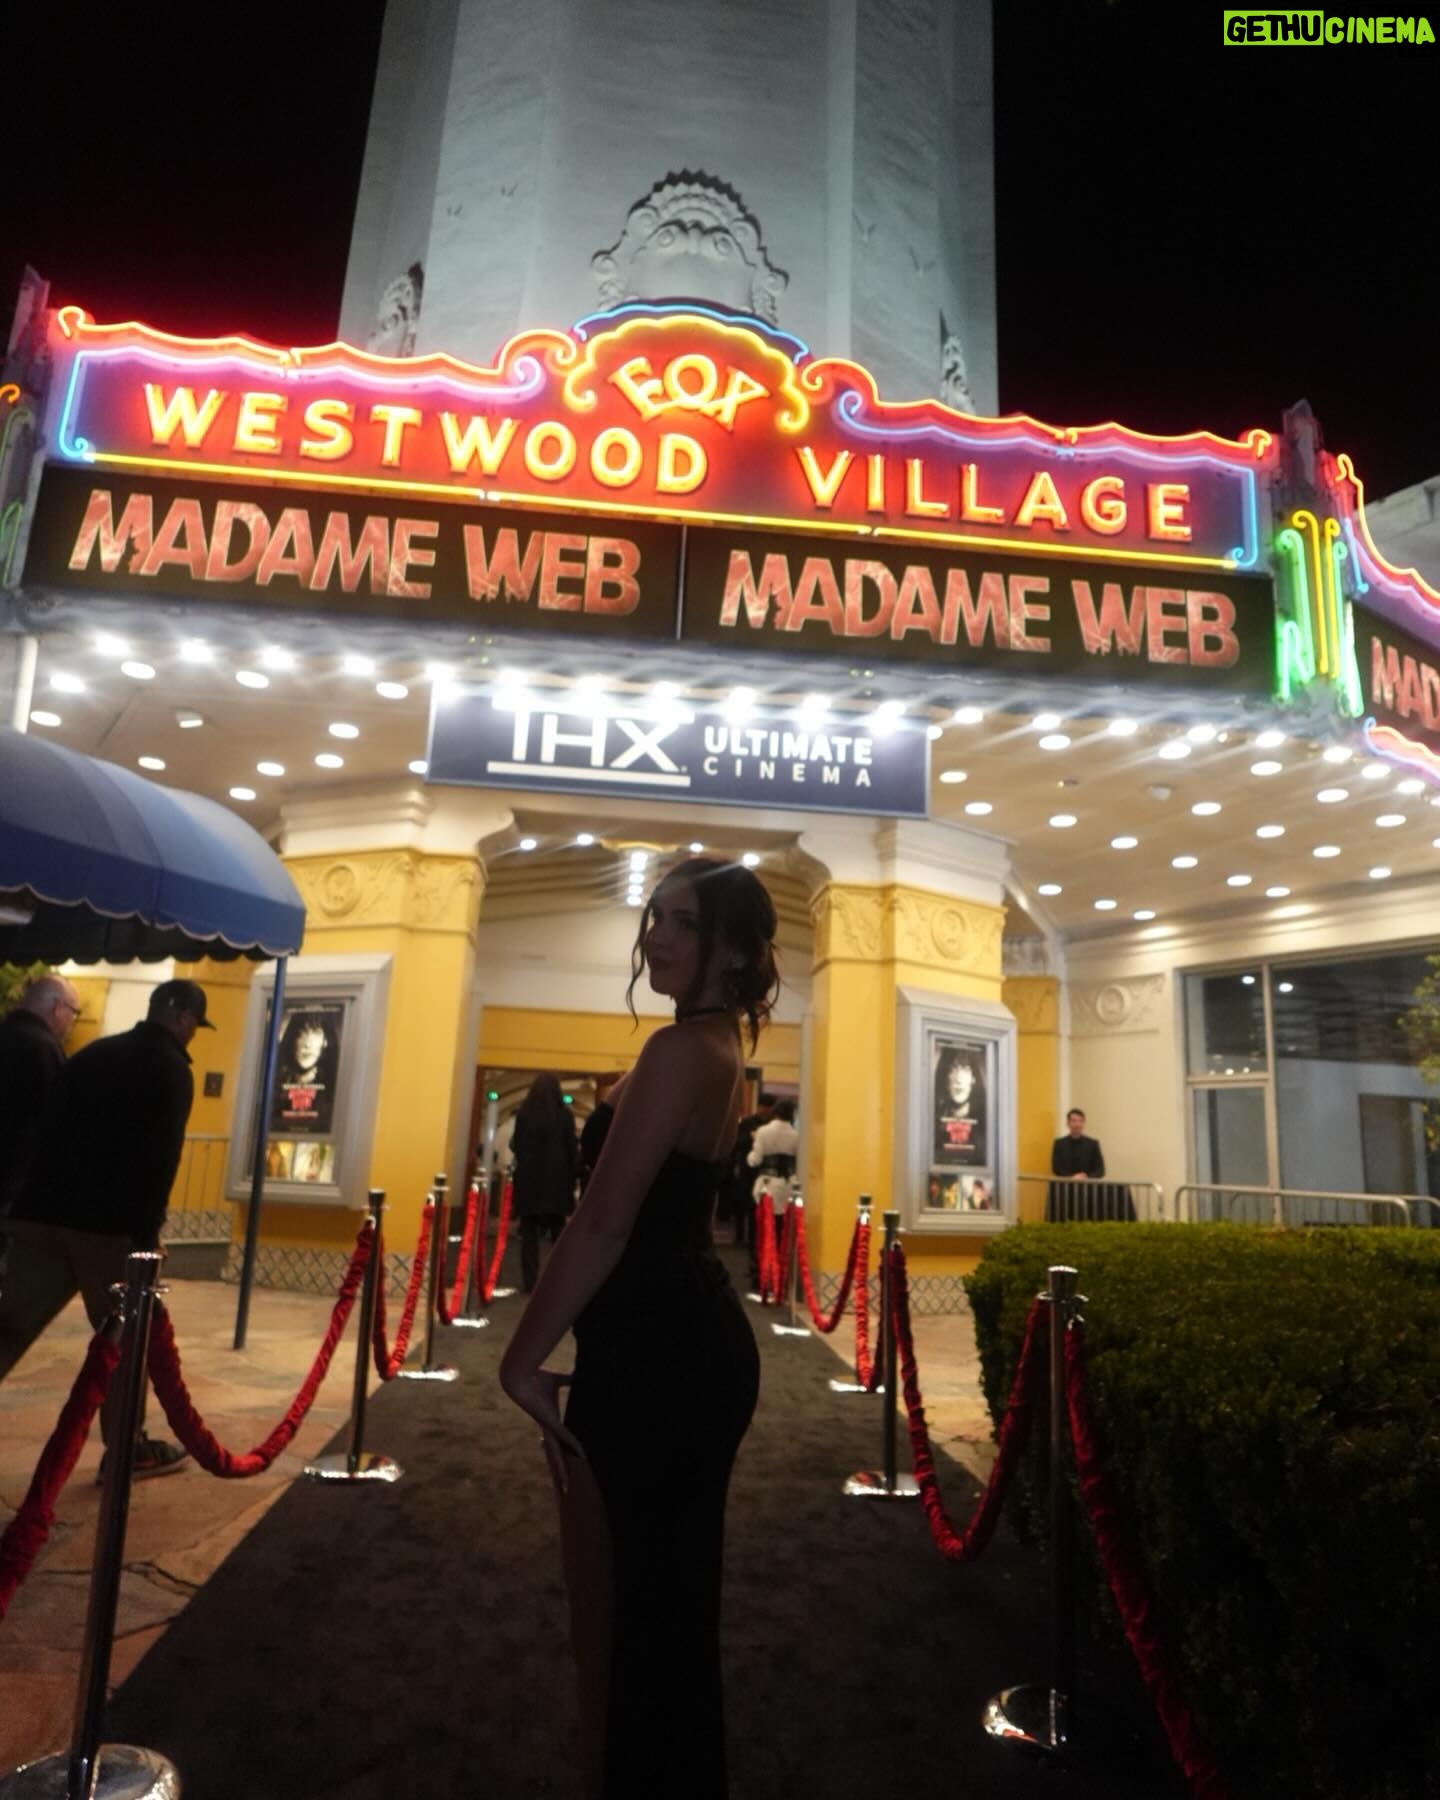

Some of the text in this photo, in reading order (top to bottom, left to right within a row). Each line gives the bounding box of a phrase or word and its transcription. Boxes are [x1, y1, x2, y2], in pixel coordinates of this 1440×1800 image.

[609, 352, 769, 431] FOX
[144, 384, 1193, 542] WESTWOOD VILLAGE
[68, 490, 641, 615] MADAME WEB
[719, 549, 1240, 669] MADAME WEB
[491, 698, 696, 774] THX
[702, 724, 874, 766] ULTIMATE
[702, 758, 873, 789] CINEMA
